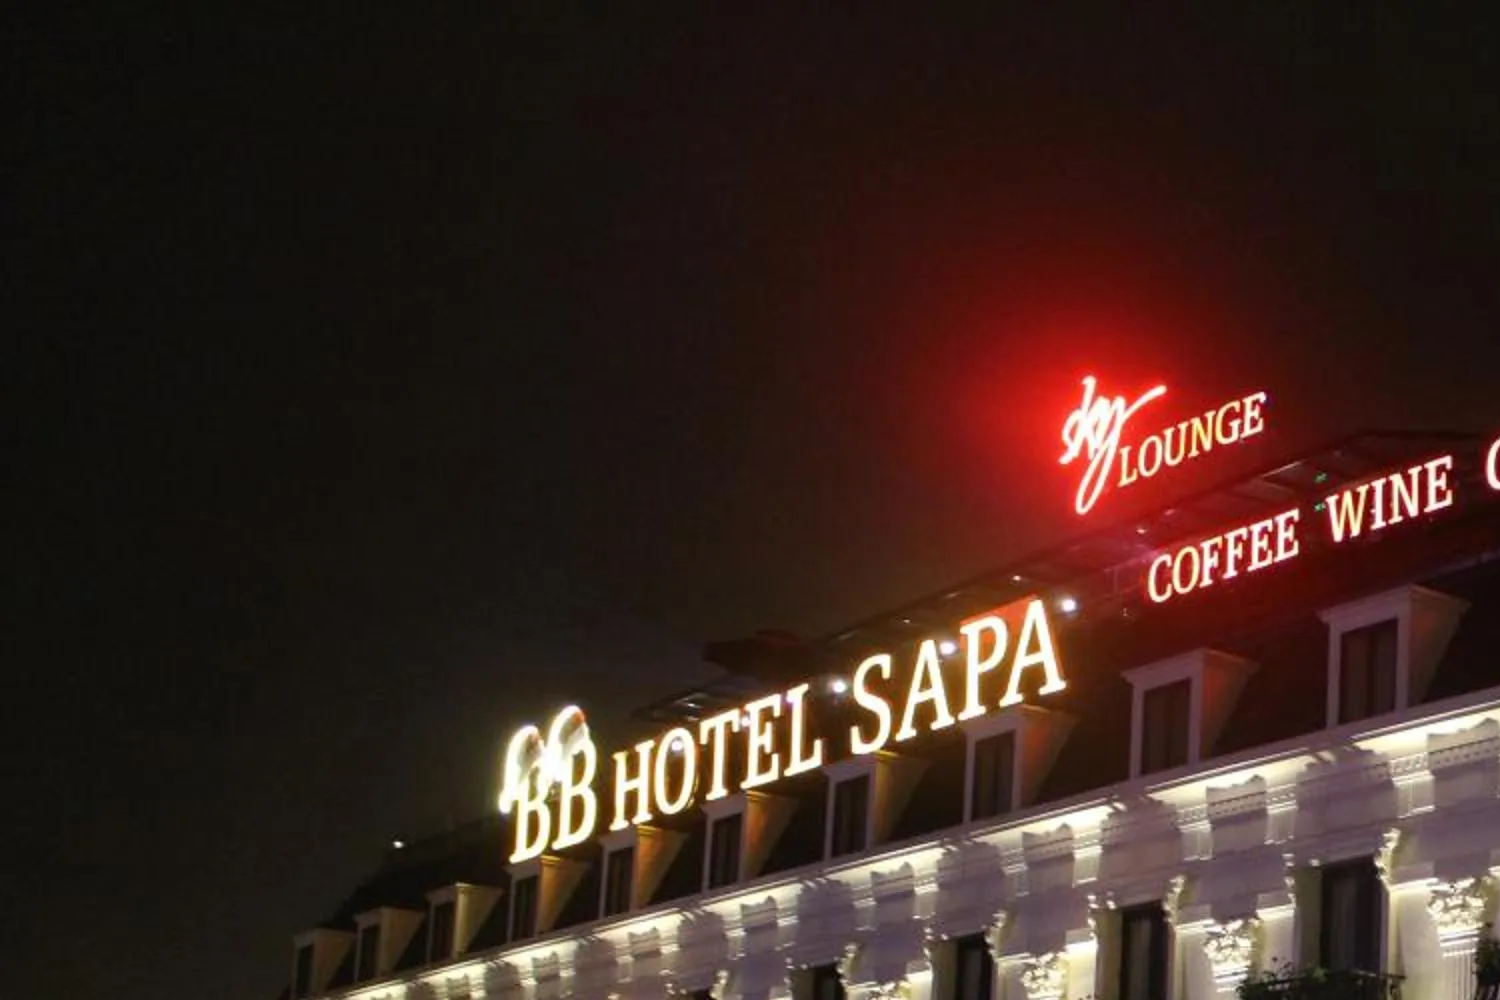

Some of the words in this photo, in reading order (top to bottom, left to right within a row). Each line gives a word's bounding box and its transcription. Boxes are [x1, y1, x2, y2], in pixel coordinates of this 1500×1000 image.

[1117, 391, 1268, 487] LOUNGE
[1146, 509, 1301, 603] COFFEE
[1325, 456, 1455, 544] WINE
[507, 735, 599, 866] BB
[607, 682, 824, 832] HOTEL
[850, 598, 1068, 756] SAPA
